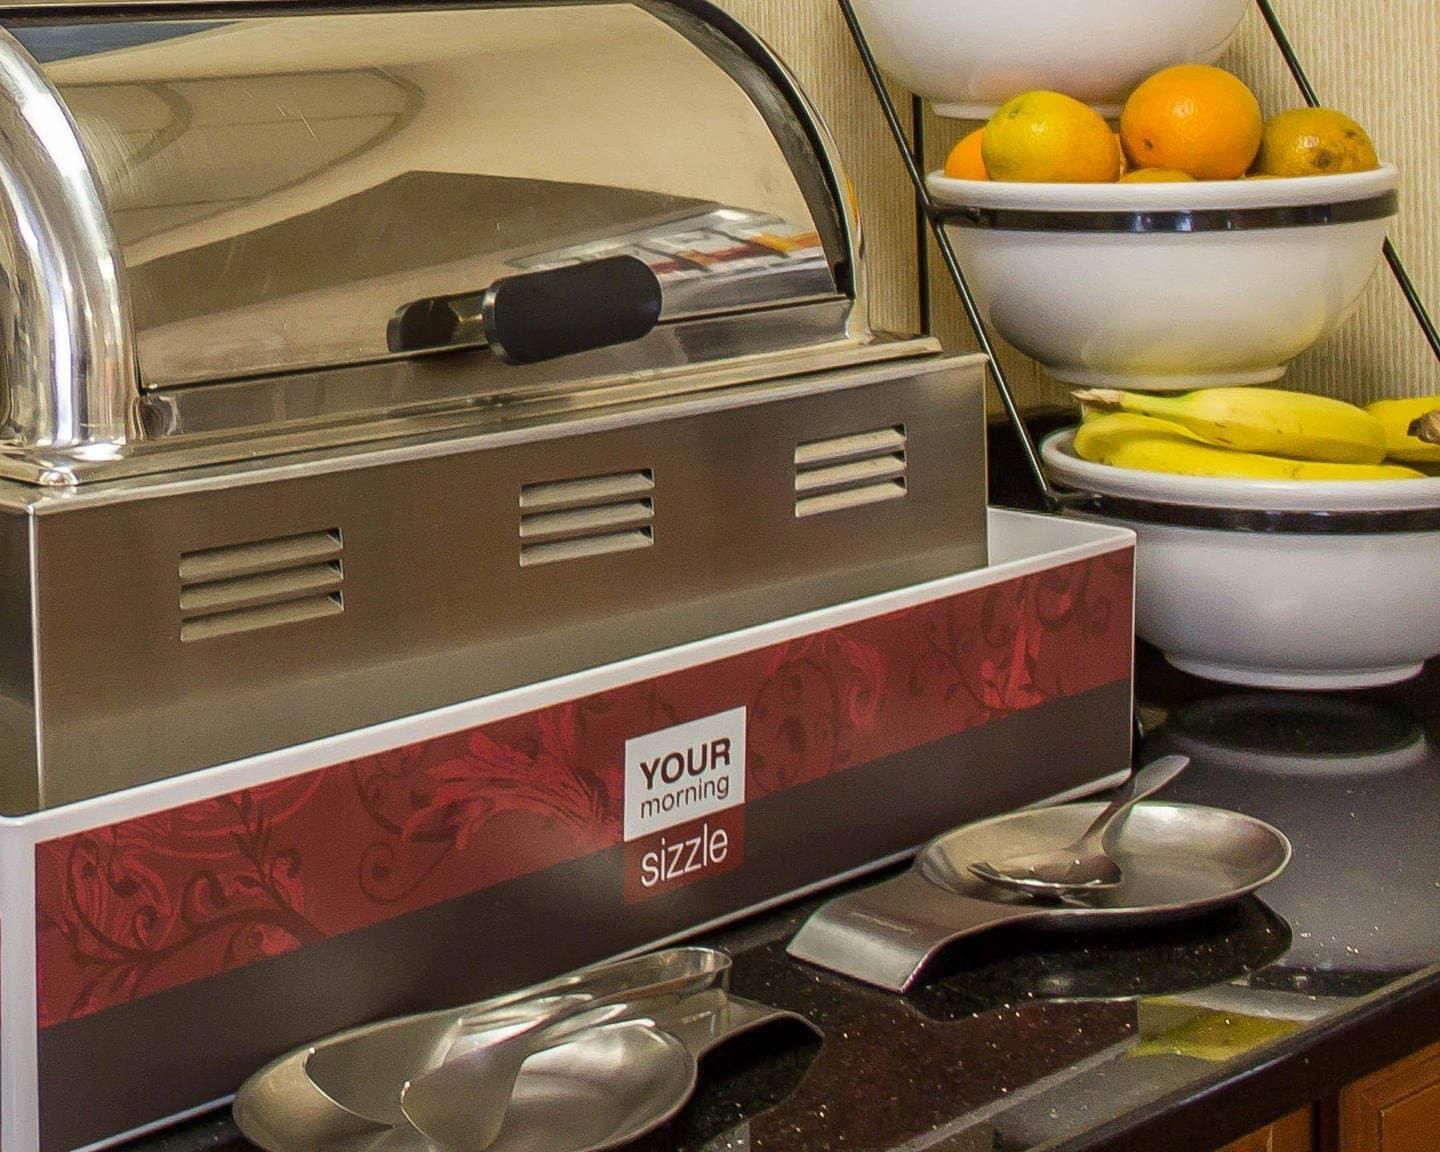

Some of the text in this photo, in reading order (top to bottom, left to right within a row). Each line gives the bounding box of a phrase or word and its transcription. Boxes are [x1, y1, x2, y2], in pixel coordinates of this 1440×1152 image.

[639, 737, 731, 791] YOUR
[640, 775, 730, 819] morning
[640, 822, 729, 888] sizzle
